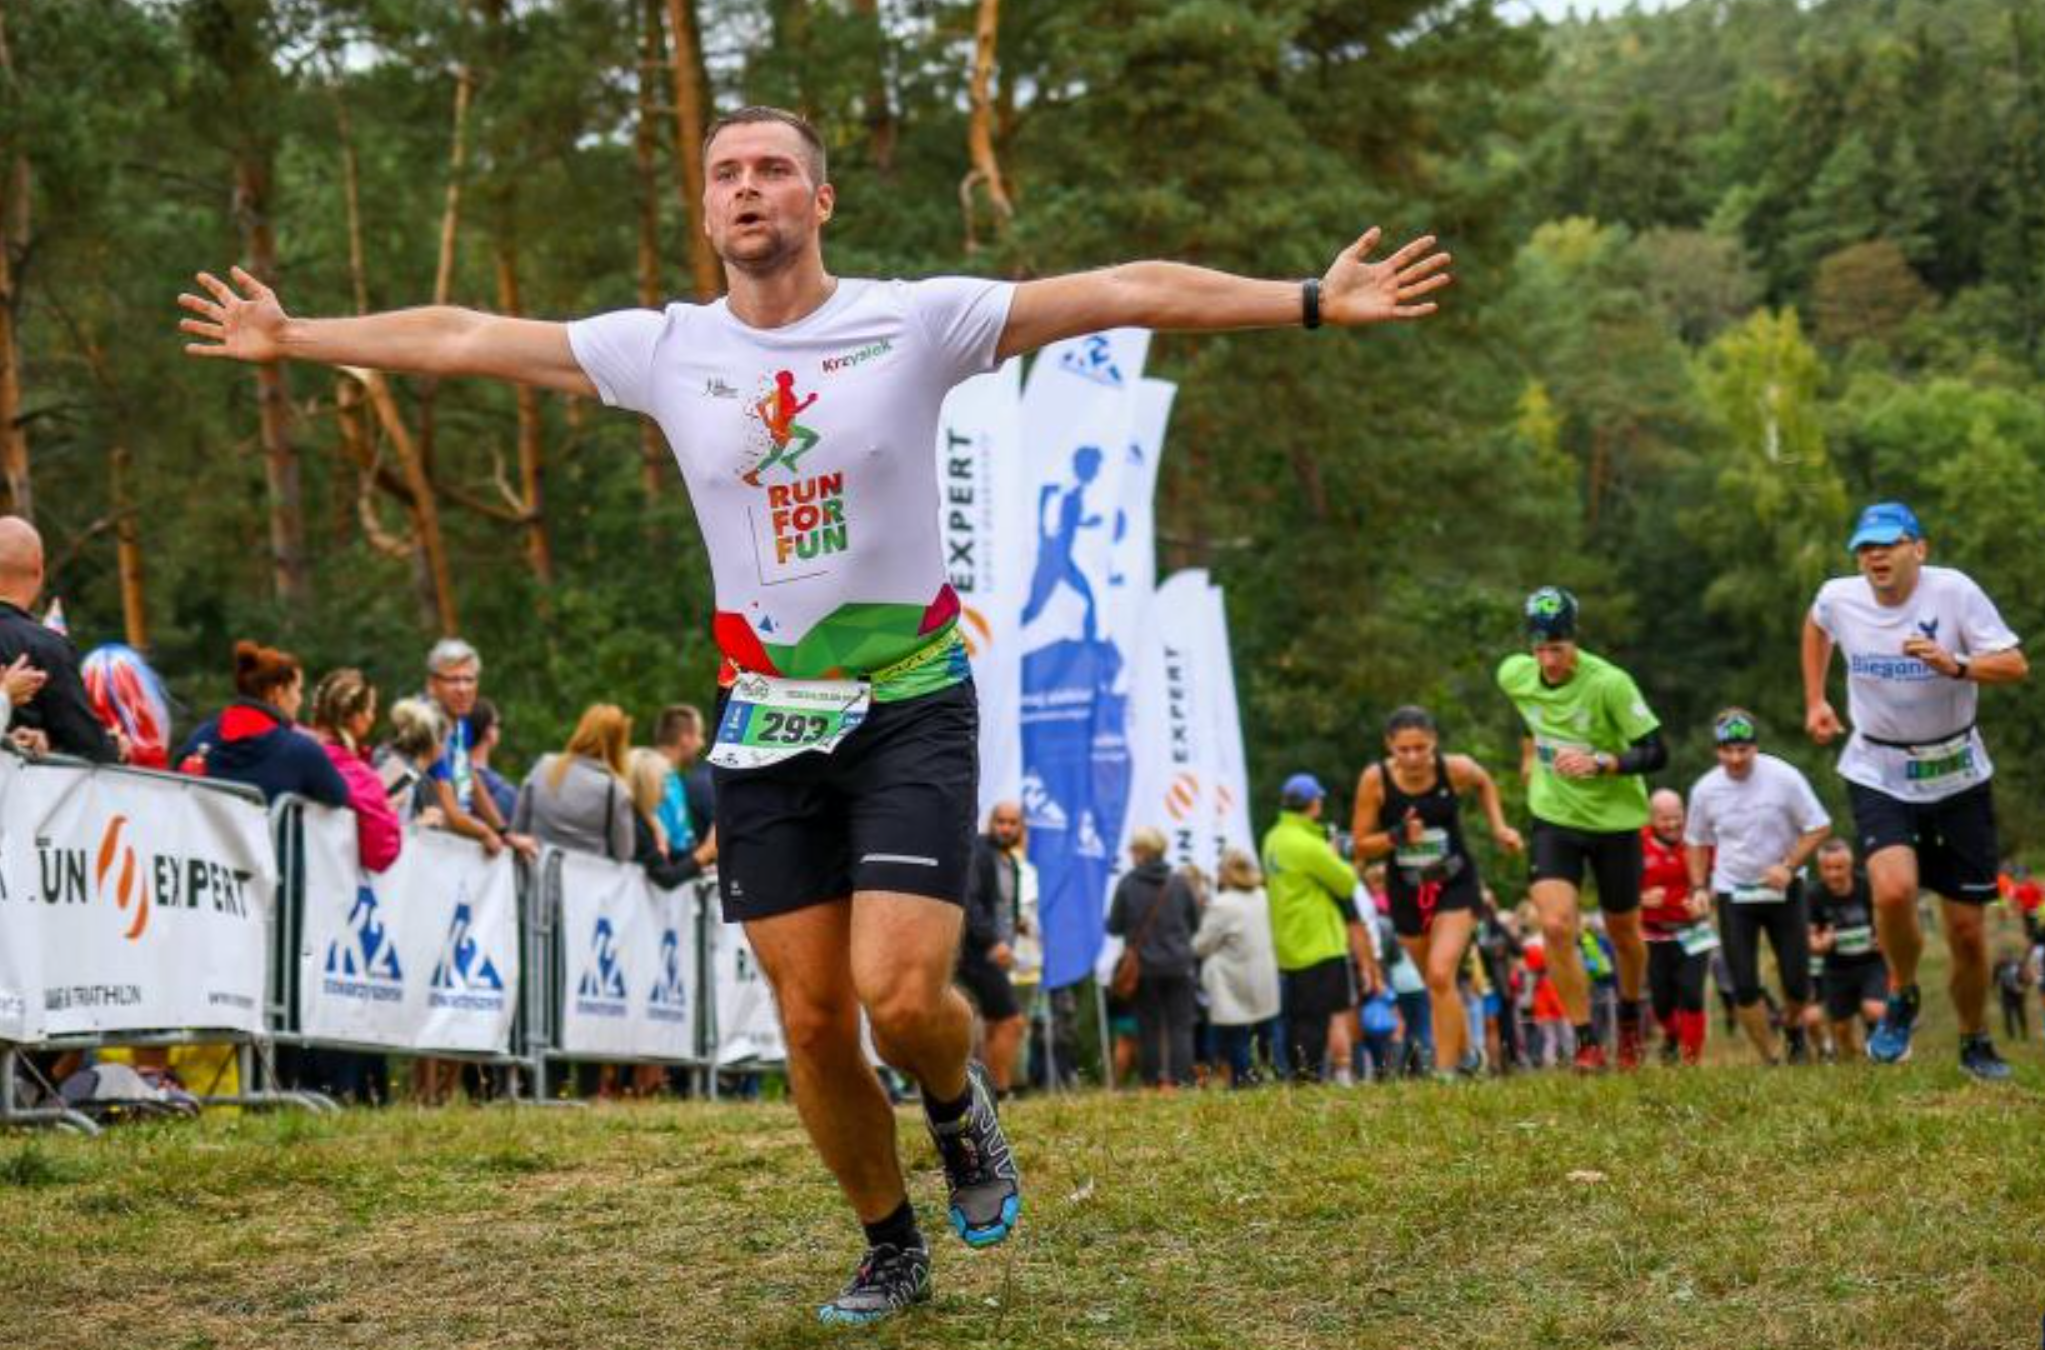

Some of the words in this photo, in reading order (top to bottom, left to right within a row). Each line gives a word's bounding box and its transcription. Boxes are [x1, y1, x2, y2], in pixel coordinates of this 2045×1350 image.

[768, 471, 845, 509] RUN
[947, 427, 975, 592] EXPERT
[771, 499, 846, 537] FOR
[774, 524, 848, 564] FUN
[1164, 646, 1189, 763] EXPERT
[757, 711, 830, 744] 293
[153, 854, 254, 920] EXPERT
